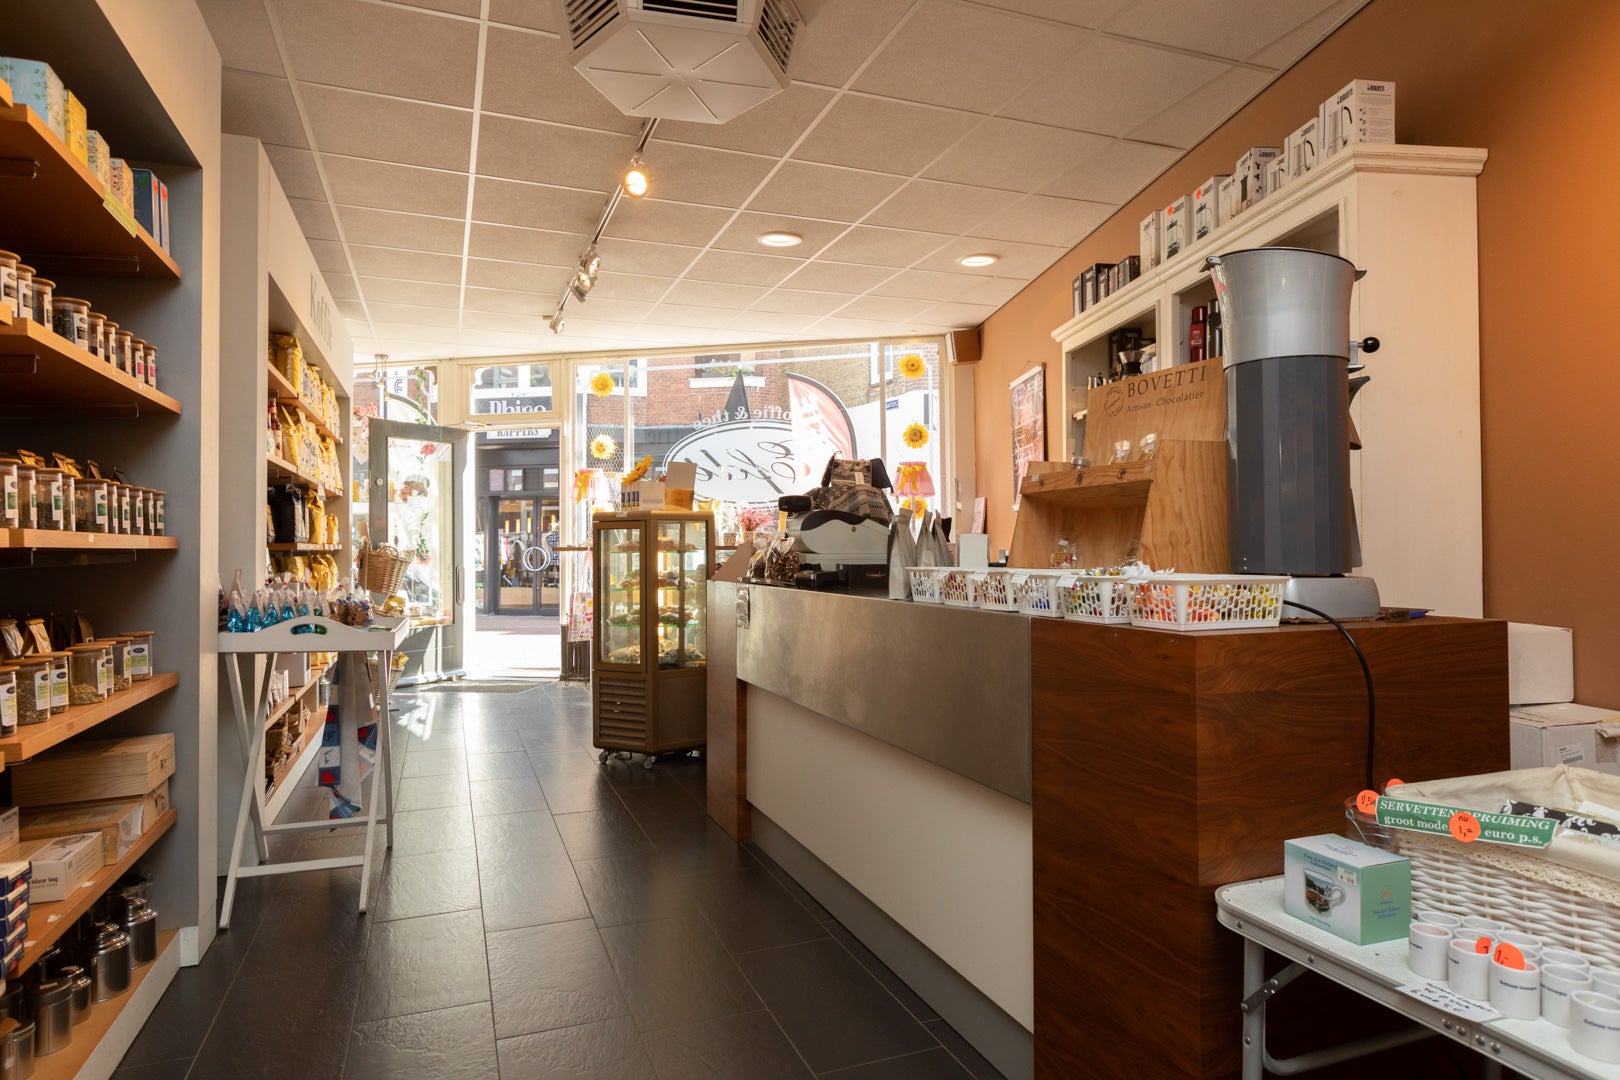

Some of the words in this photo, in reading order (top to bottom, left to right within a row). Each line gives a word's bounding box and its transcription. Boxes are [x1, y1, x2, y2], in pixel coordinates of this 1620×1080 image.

[1127, 365, 1207, 398] BOVETTI
[1126, 401, 1152, 414] Artisan
[1155, 391, 1204, 407] Chocolatier
[1383, 815, 1415, 826] groot
[1484, 828, 1516, 841] euro
[1519, 834, 1543, 845] p.s.
[1467, 811, 1550, 831] PRUIMING
